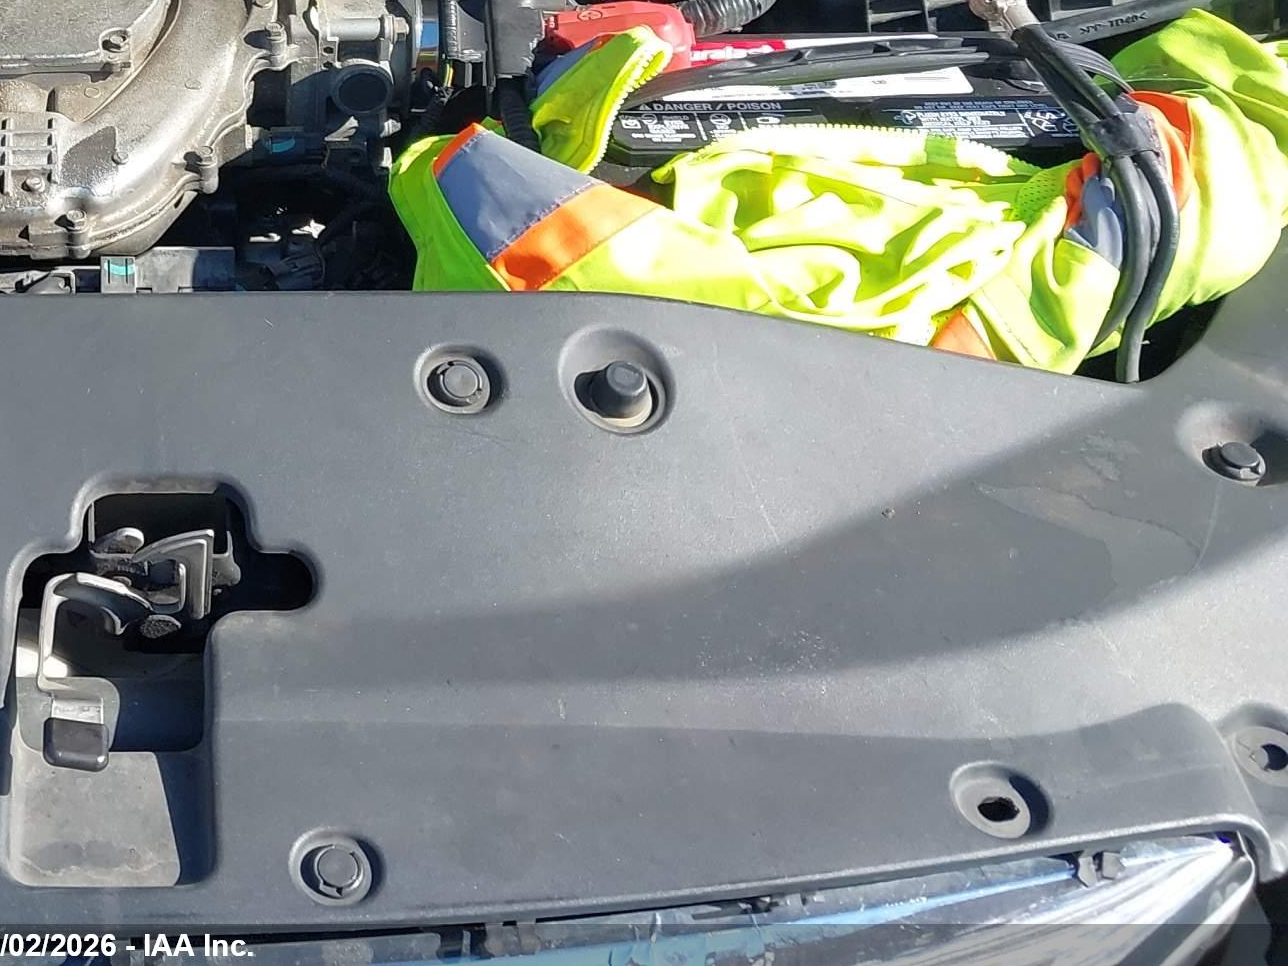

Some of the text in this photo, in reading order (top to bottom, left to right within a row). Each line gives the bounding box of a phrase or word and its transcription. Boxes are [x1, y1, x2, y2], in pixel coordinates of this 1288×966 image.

[689, 44, 775, 62] uralast
[653, 102, 713, 111] DANGER
[727, 102, 782, 111] POISON
